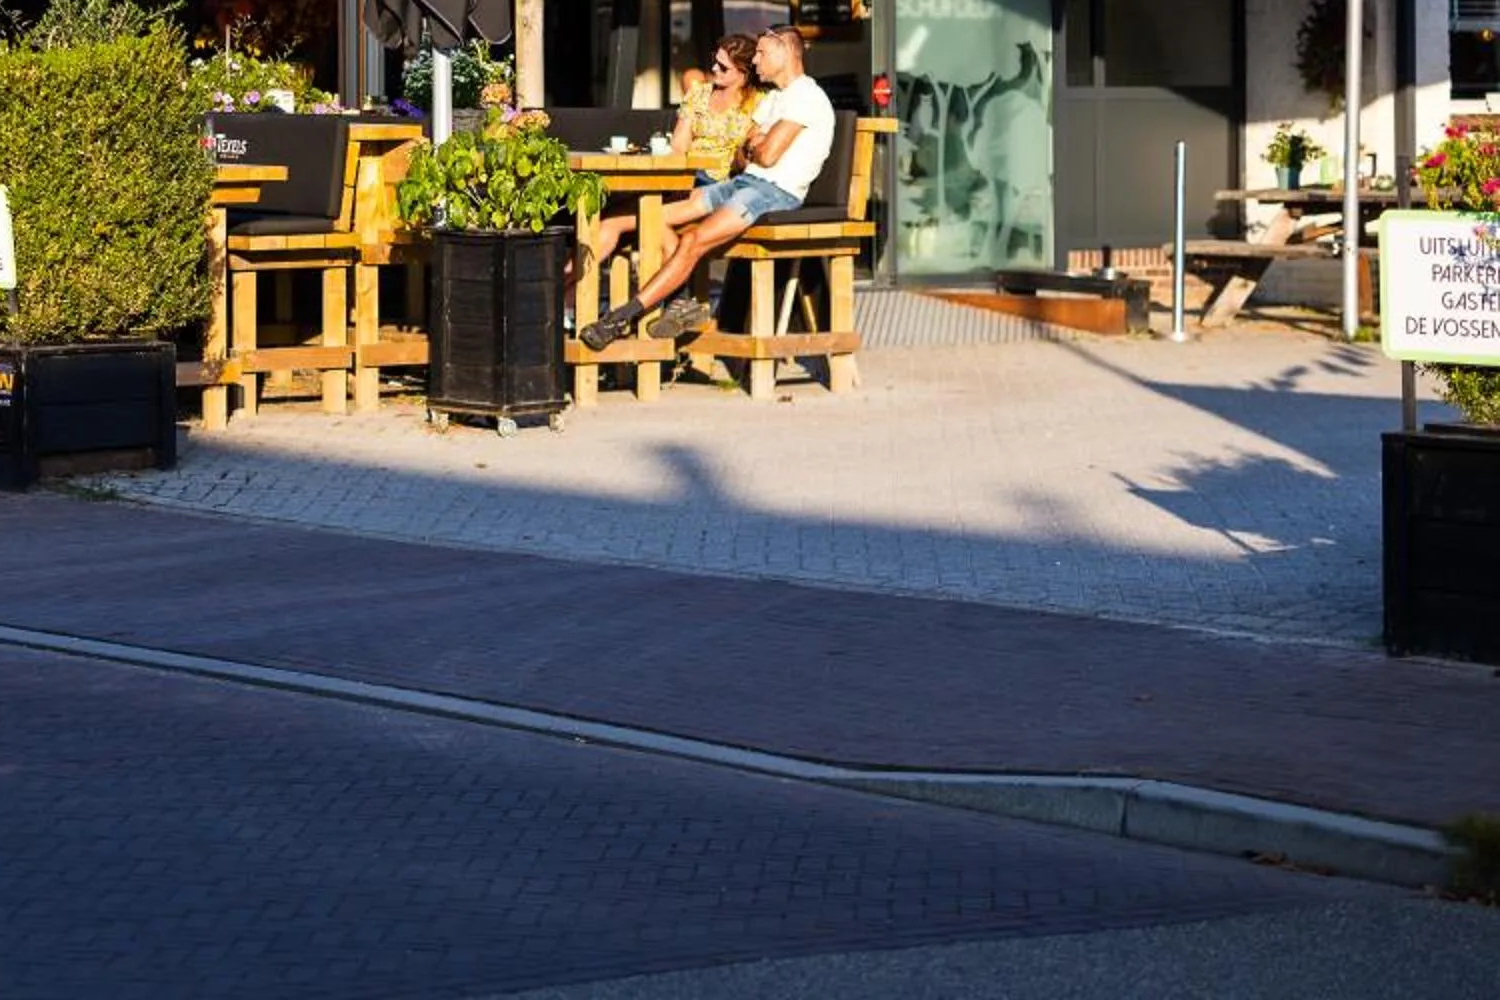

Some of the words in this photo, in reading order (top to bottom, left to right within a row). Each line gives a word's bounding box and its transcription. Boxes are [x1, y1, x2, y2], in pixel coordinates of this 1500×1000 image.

[1432, 263, 1500, 284] PARKER
[1441, 291, 1500, 312] GASTE
[1405, 315, 1427, 335] DE
